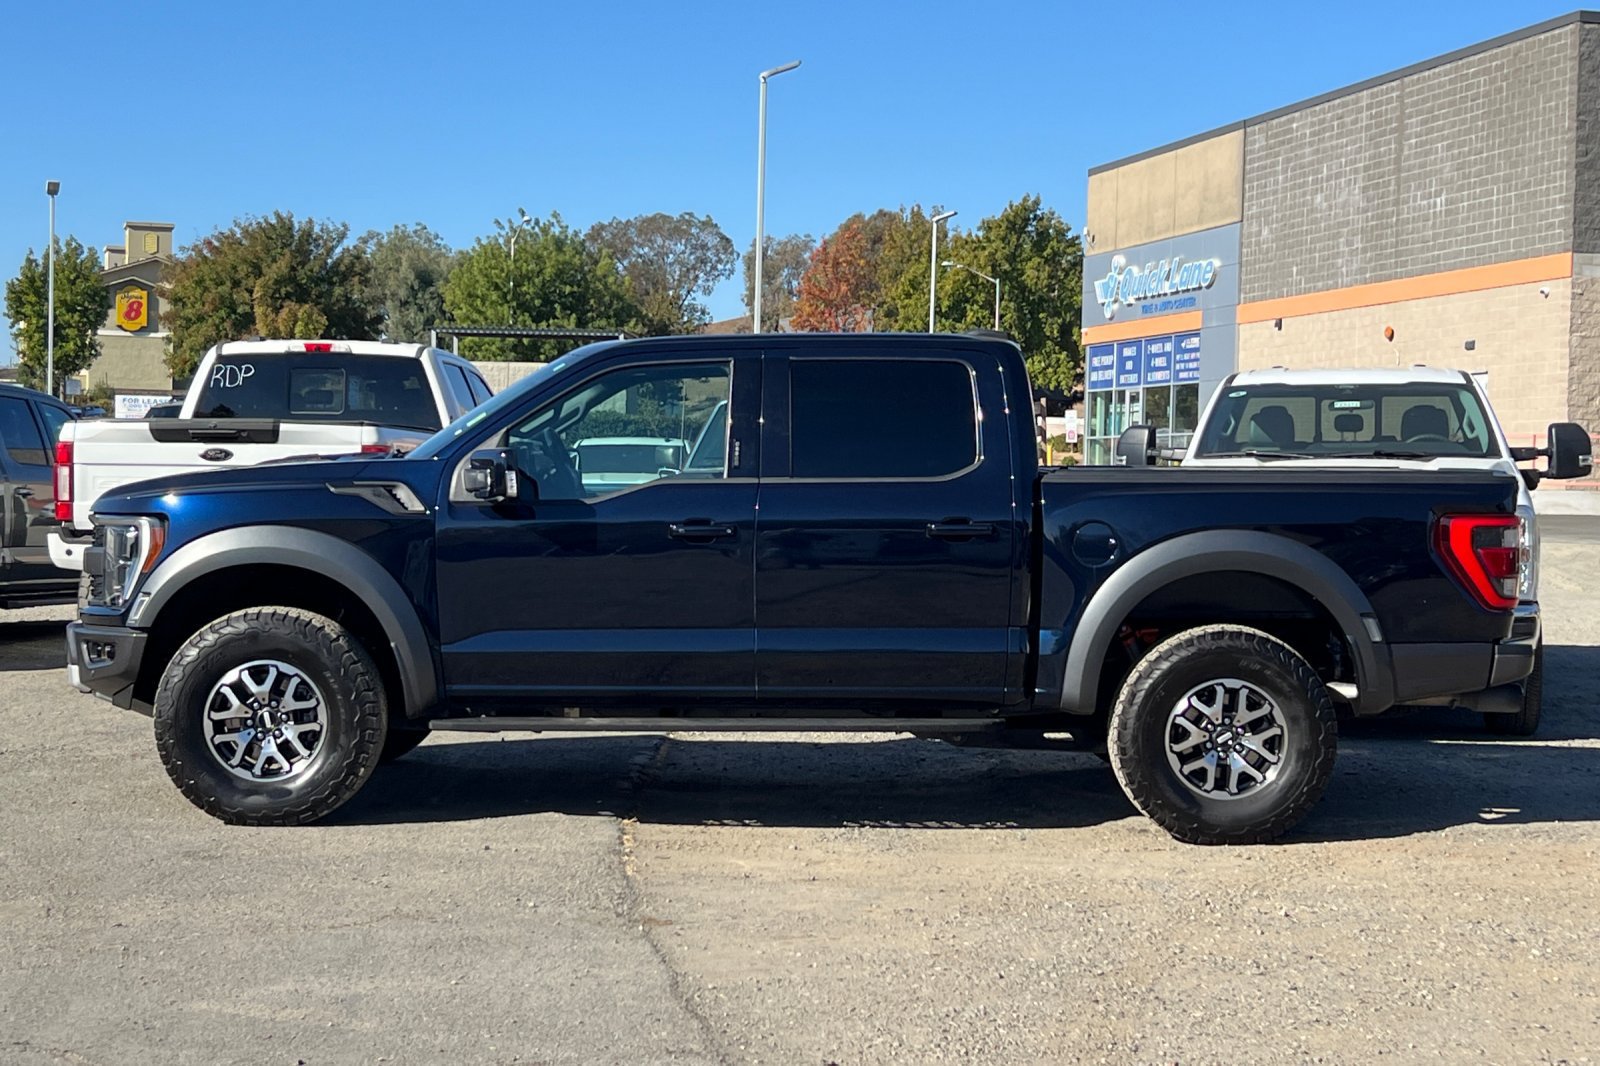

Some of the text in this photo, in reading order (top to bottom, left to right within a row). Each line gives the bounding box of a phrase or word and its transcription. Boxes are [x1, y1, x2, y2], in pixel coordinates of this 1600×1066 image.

[1120, 257, 1216, 304] Quick Lane
[123, 300, 144, 321] 8
[210, 364, 255, 388] RDP
[122, 397, 139, 405] FOR
